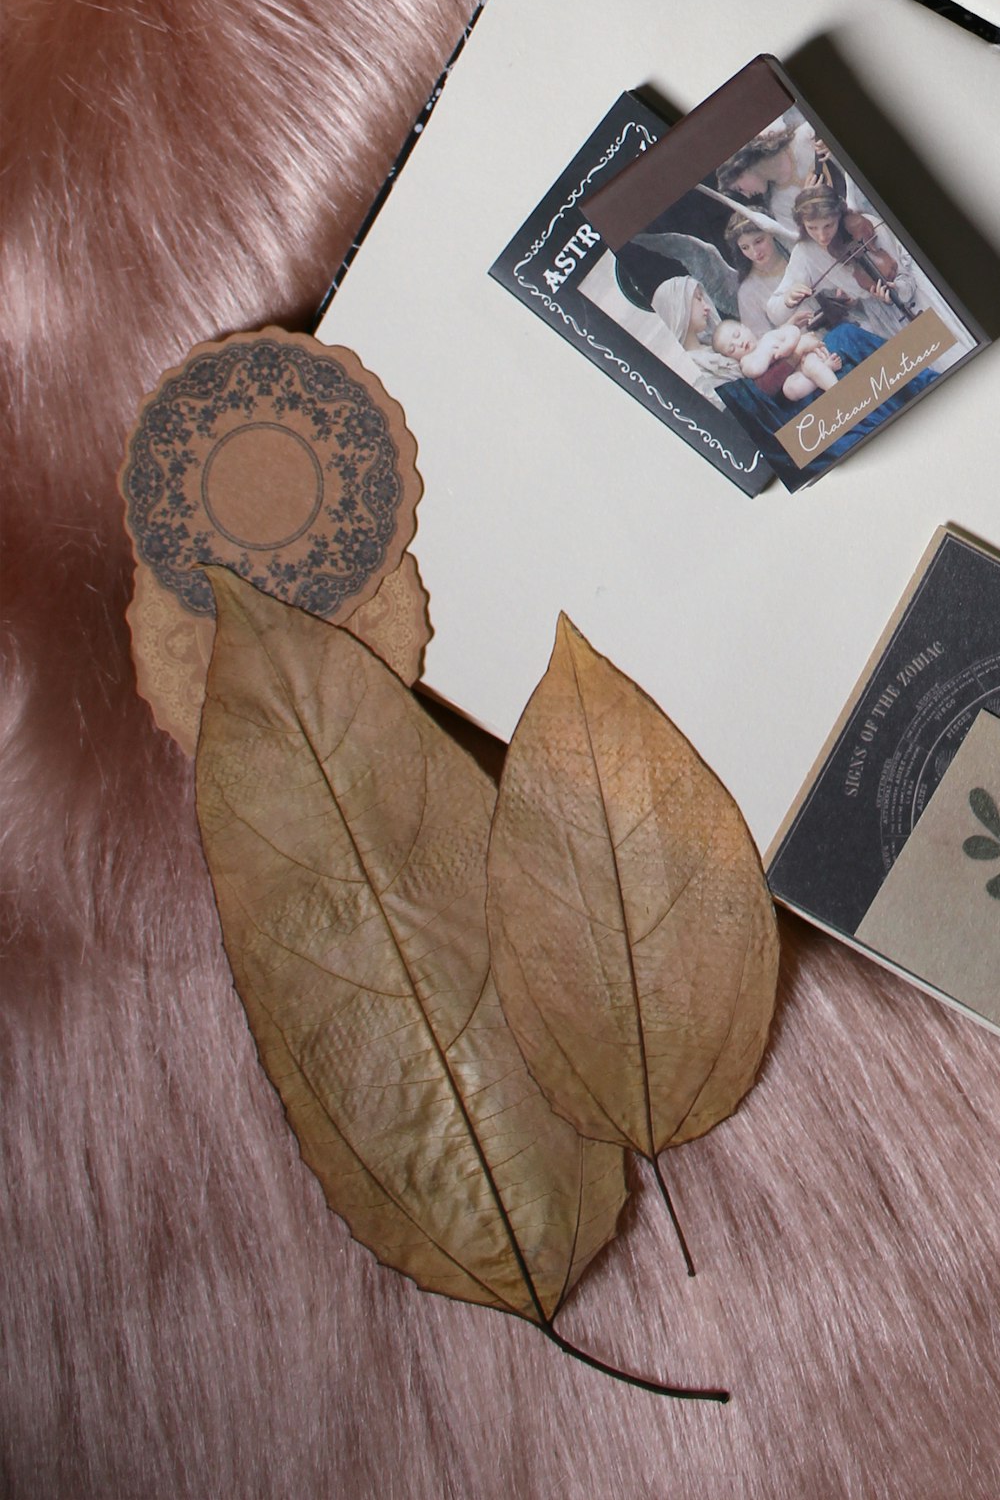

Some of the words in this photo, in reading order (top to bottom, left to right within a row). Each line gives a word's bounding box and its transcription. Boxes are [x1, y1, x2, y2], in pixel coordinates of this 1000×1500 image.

[542, 222, 602, 293] ASTR
[796, 397, 870, 449] Chateau
[845, 748, 868, 799] SIGNS
[861, 720, 880, 743] OF
[871, 684, 900, 719] THE
[897, 640, 945, 687] ZODIAC
[934, 698, 957, 721] VIRGO
[946, 712, 972, 739] PISCES
